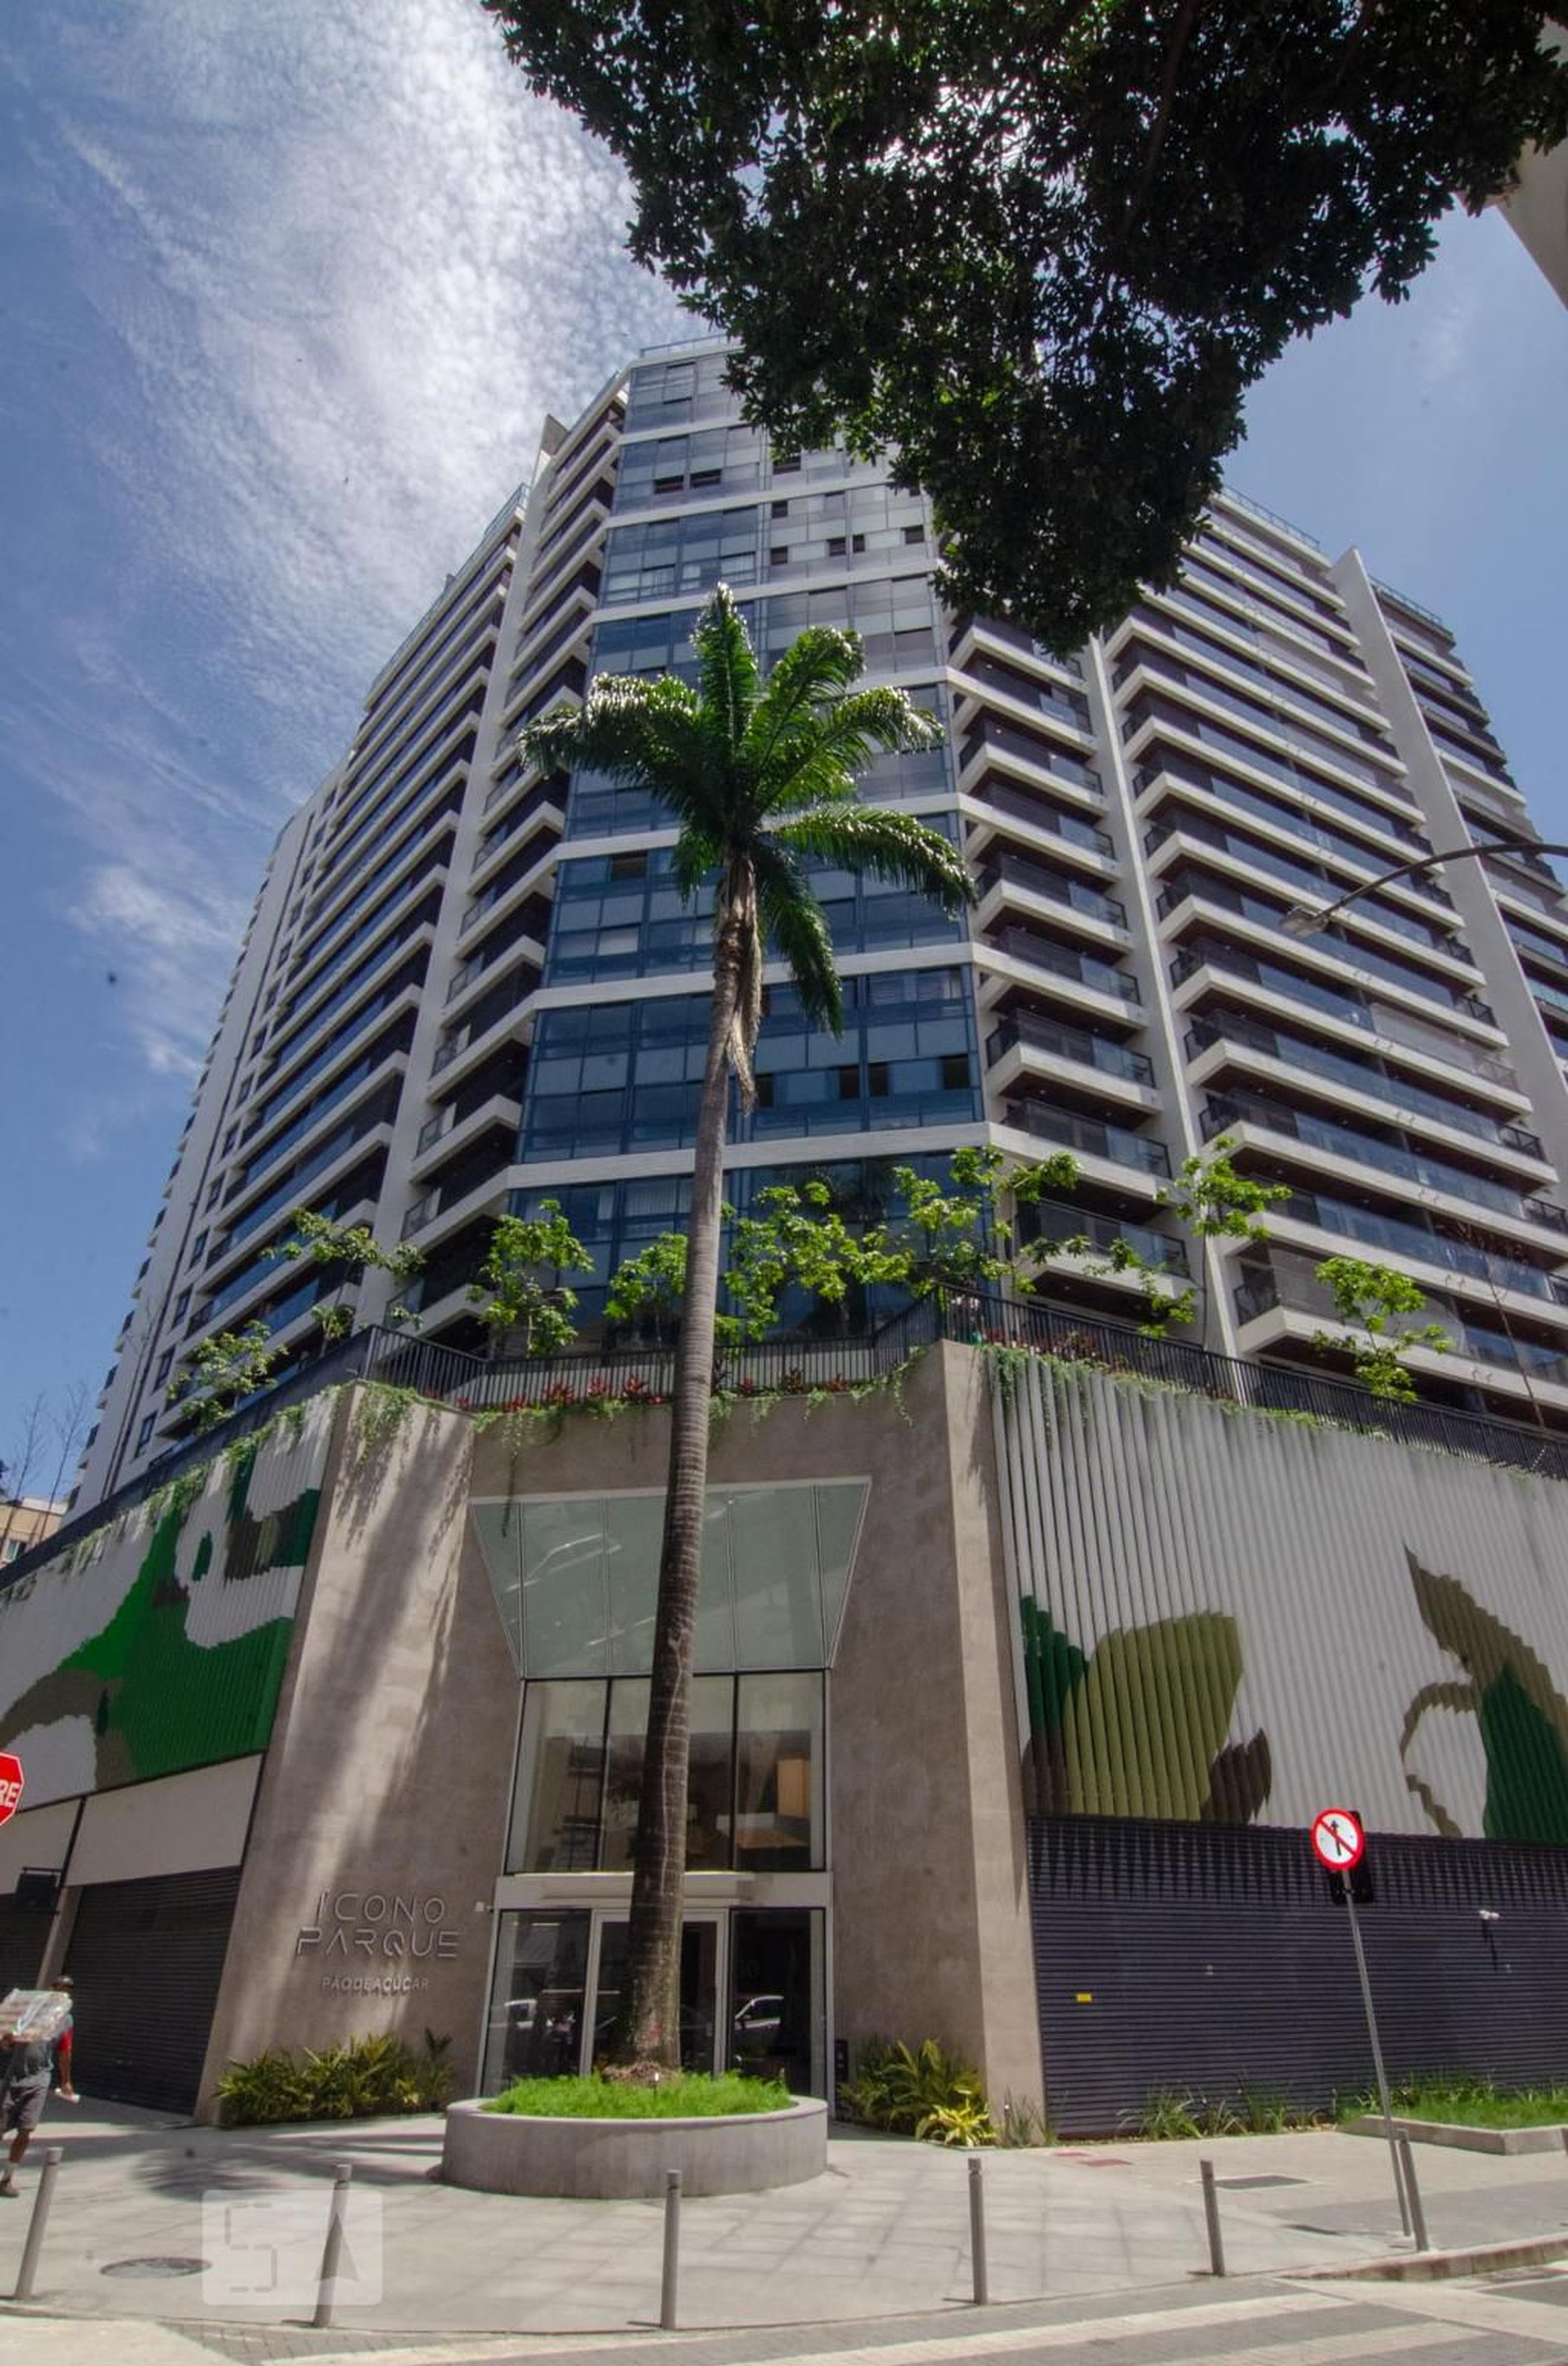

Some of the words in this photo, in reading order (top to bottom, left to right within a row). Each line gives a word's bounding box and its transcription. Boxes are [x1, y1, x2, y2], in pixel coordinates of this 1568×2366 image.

[0, 1778, 20, 1808] RE
[317, 1887, 445, 1924] ICONO
[297, 1926, 460, 1958] PARQUE
